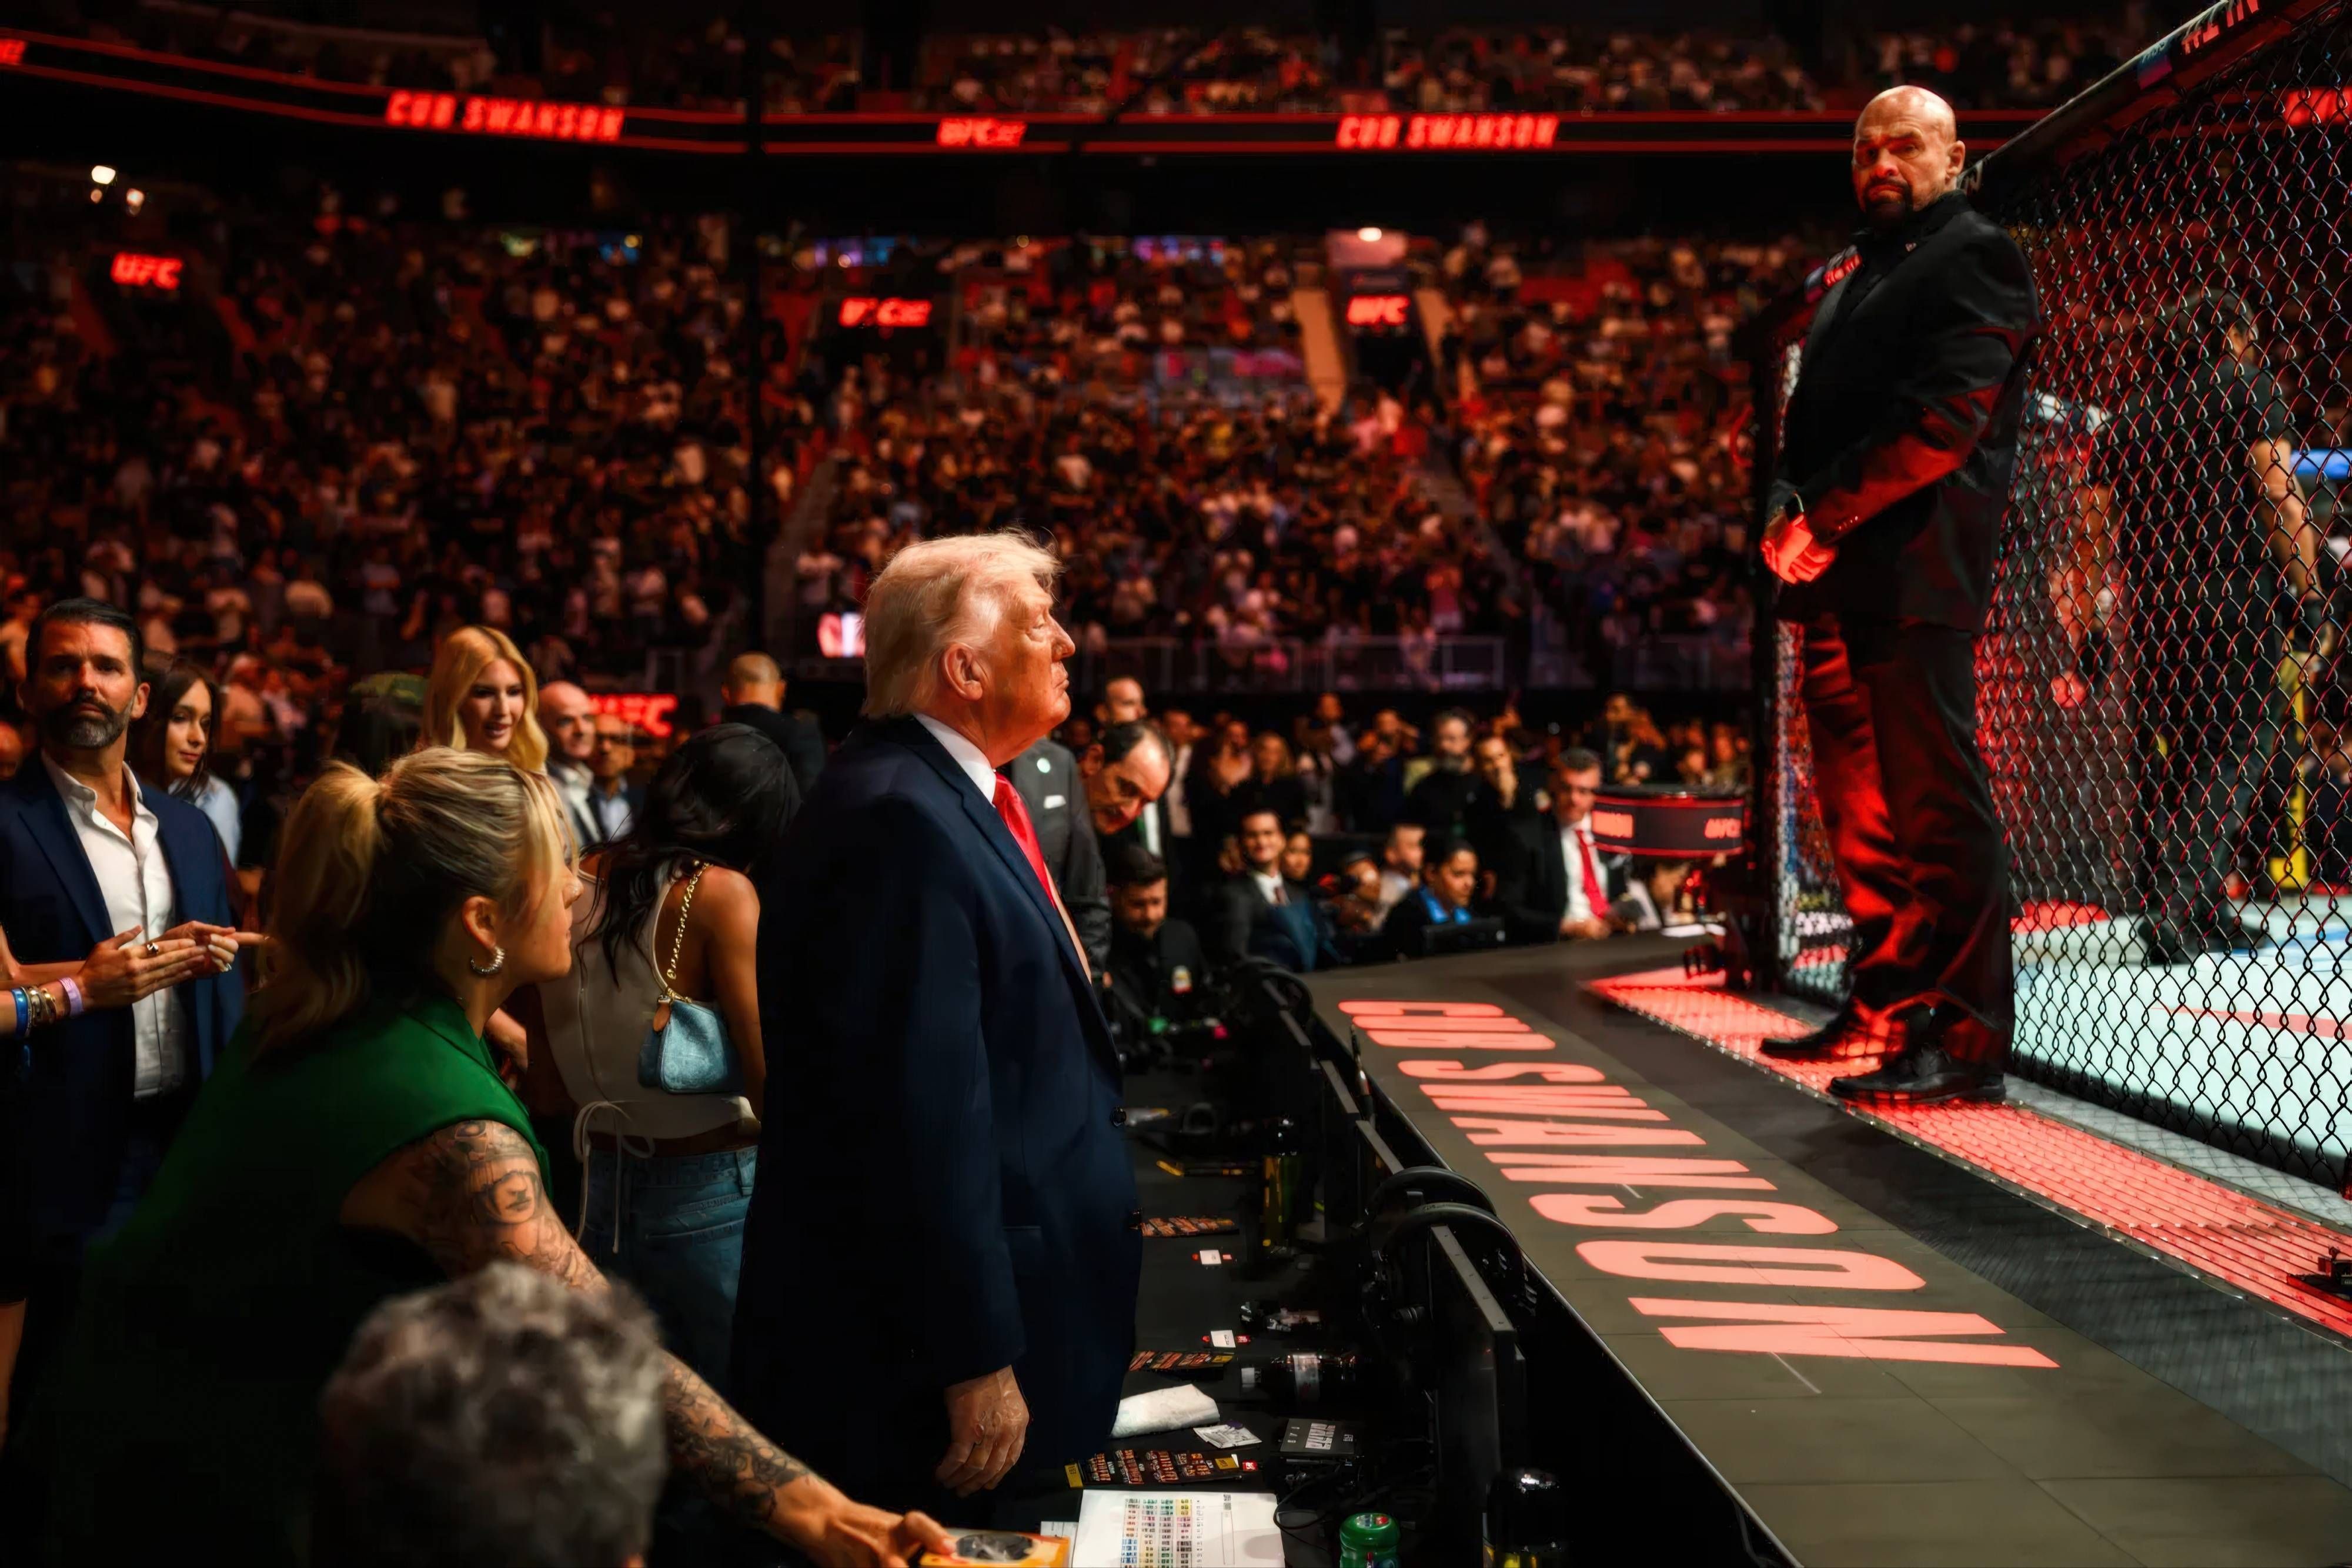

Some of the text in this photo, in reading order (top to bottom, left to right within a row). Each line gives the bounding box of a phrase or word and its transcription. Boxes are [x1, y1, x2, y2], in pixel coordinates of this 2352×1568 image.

[462, 96, 625, 142] SWANSON
[111, 252, 182, 289] UFC
[1338, 1001, 2061, 1368] CUB SWANSON
